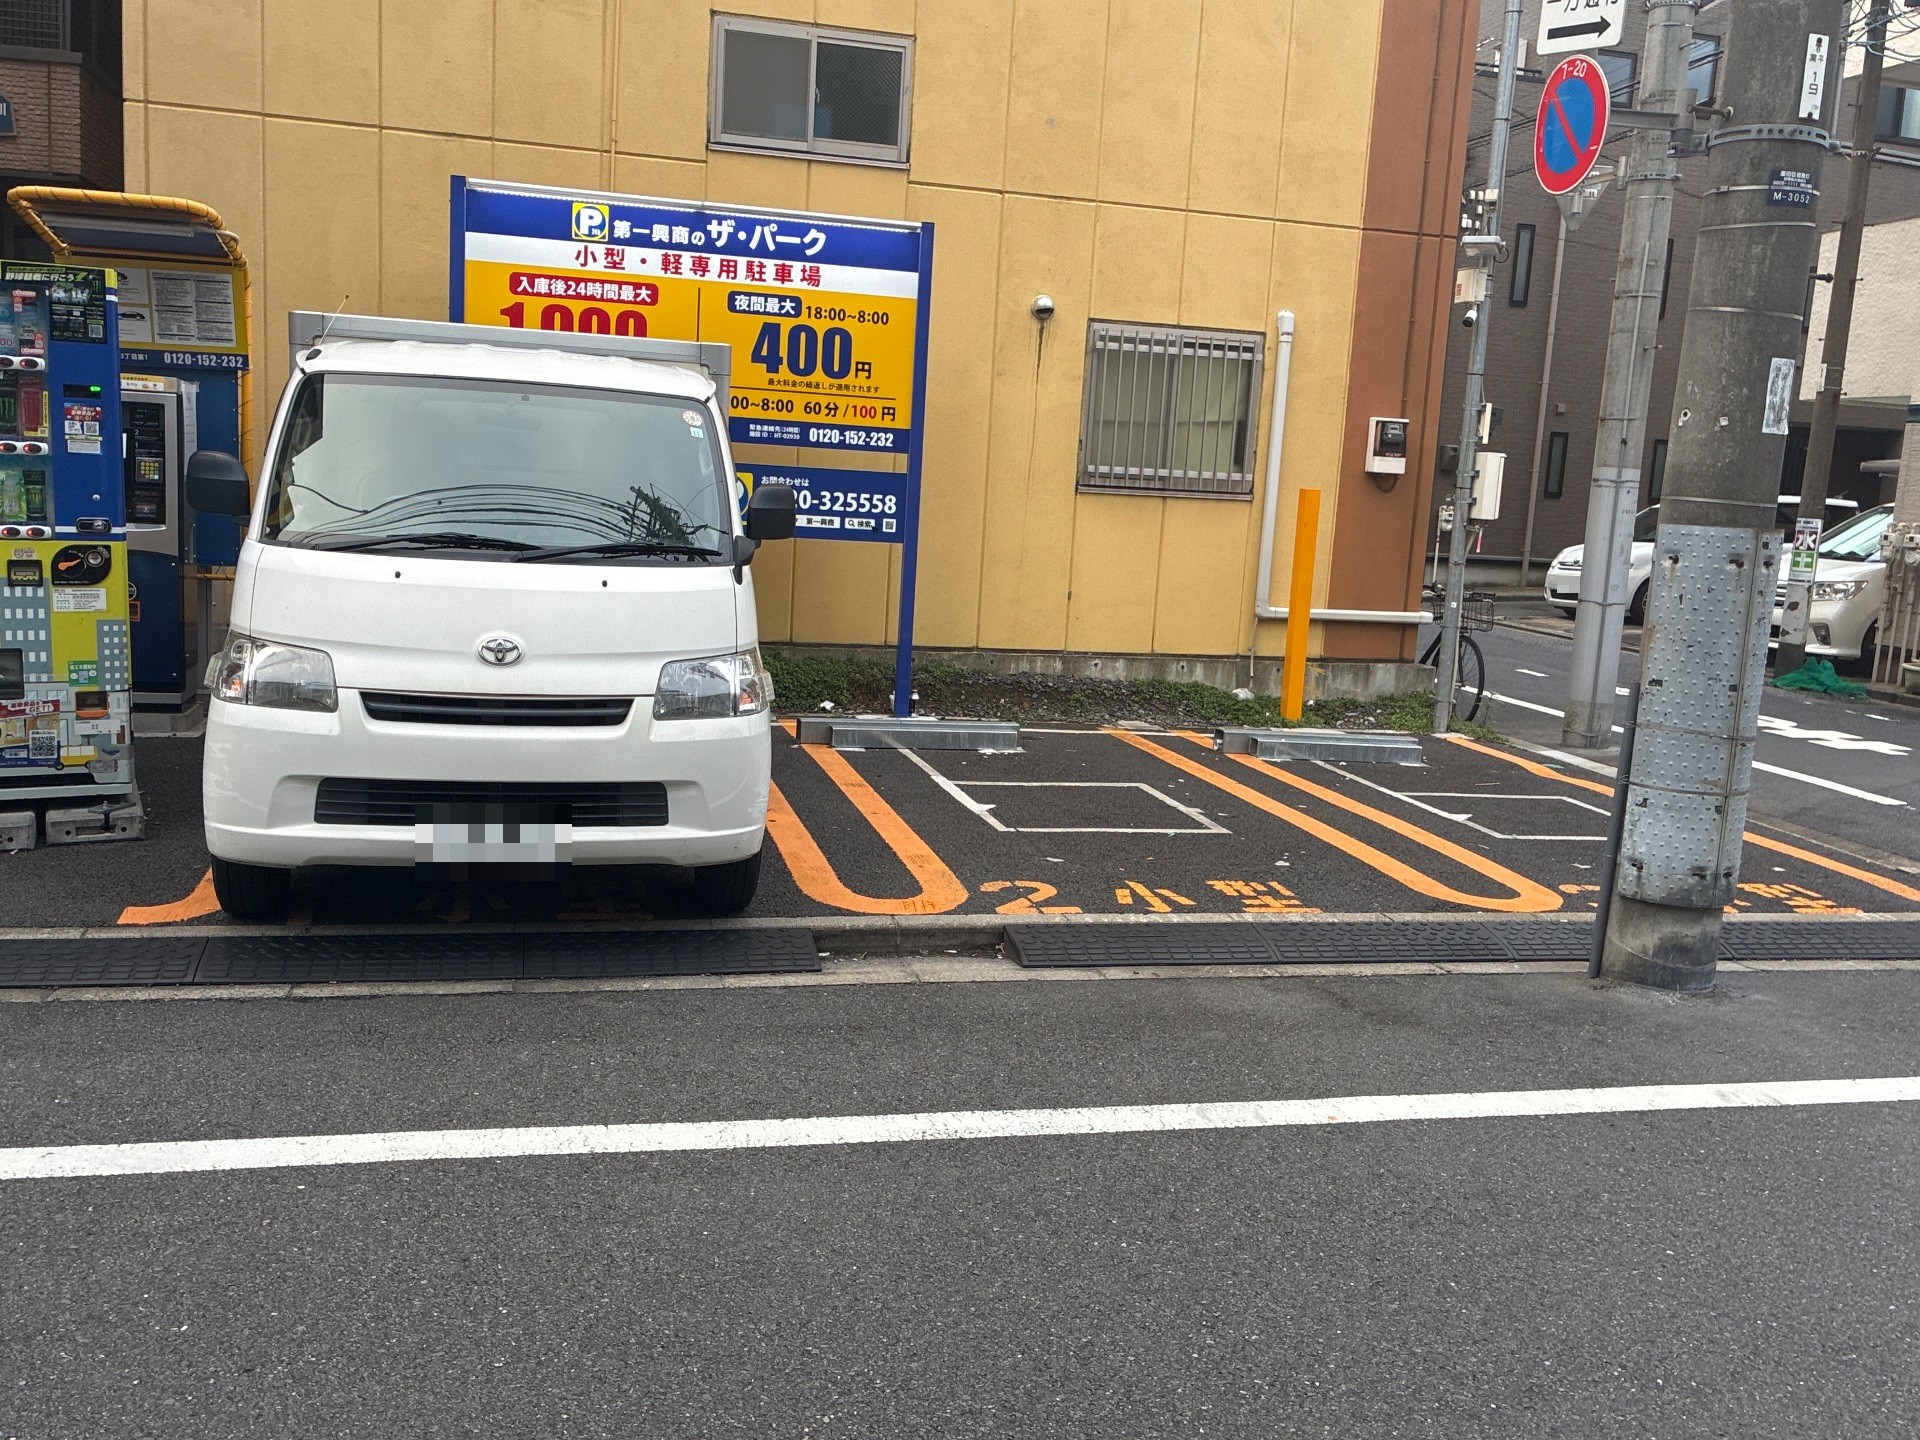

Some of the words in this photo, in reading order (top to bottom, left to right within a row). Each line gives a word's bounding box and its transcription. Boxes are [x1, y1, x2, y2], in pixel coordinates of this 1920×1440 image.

[1808, 71, 1818, 95] 19
[1773, 191, 1810, 204] M-3052
[580, 208, 603, 235] P
[613, 219, 827, 256] 第一興商のザ・パーク
[575, 245, 822, 288] 小型・軽専用駐車場
[517, 276, 652, 303] 入庫後24時間最大
[734, 294, 796, 315] 夜間最大
[163, 352, 244, 368] 0120-152-232
[809, 427, 894, 447] 0120-152-232
[979, 880, 1084, 915] 2
